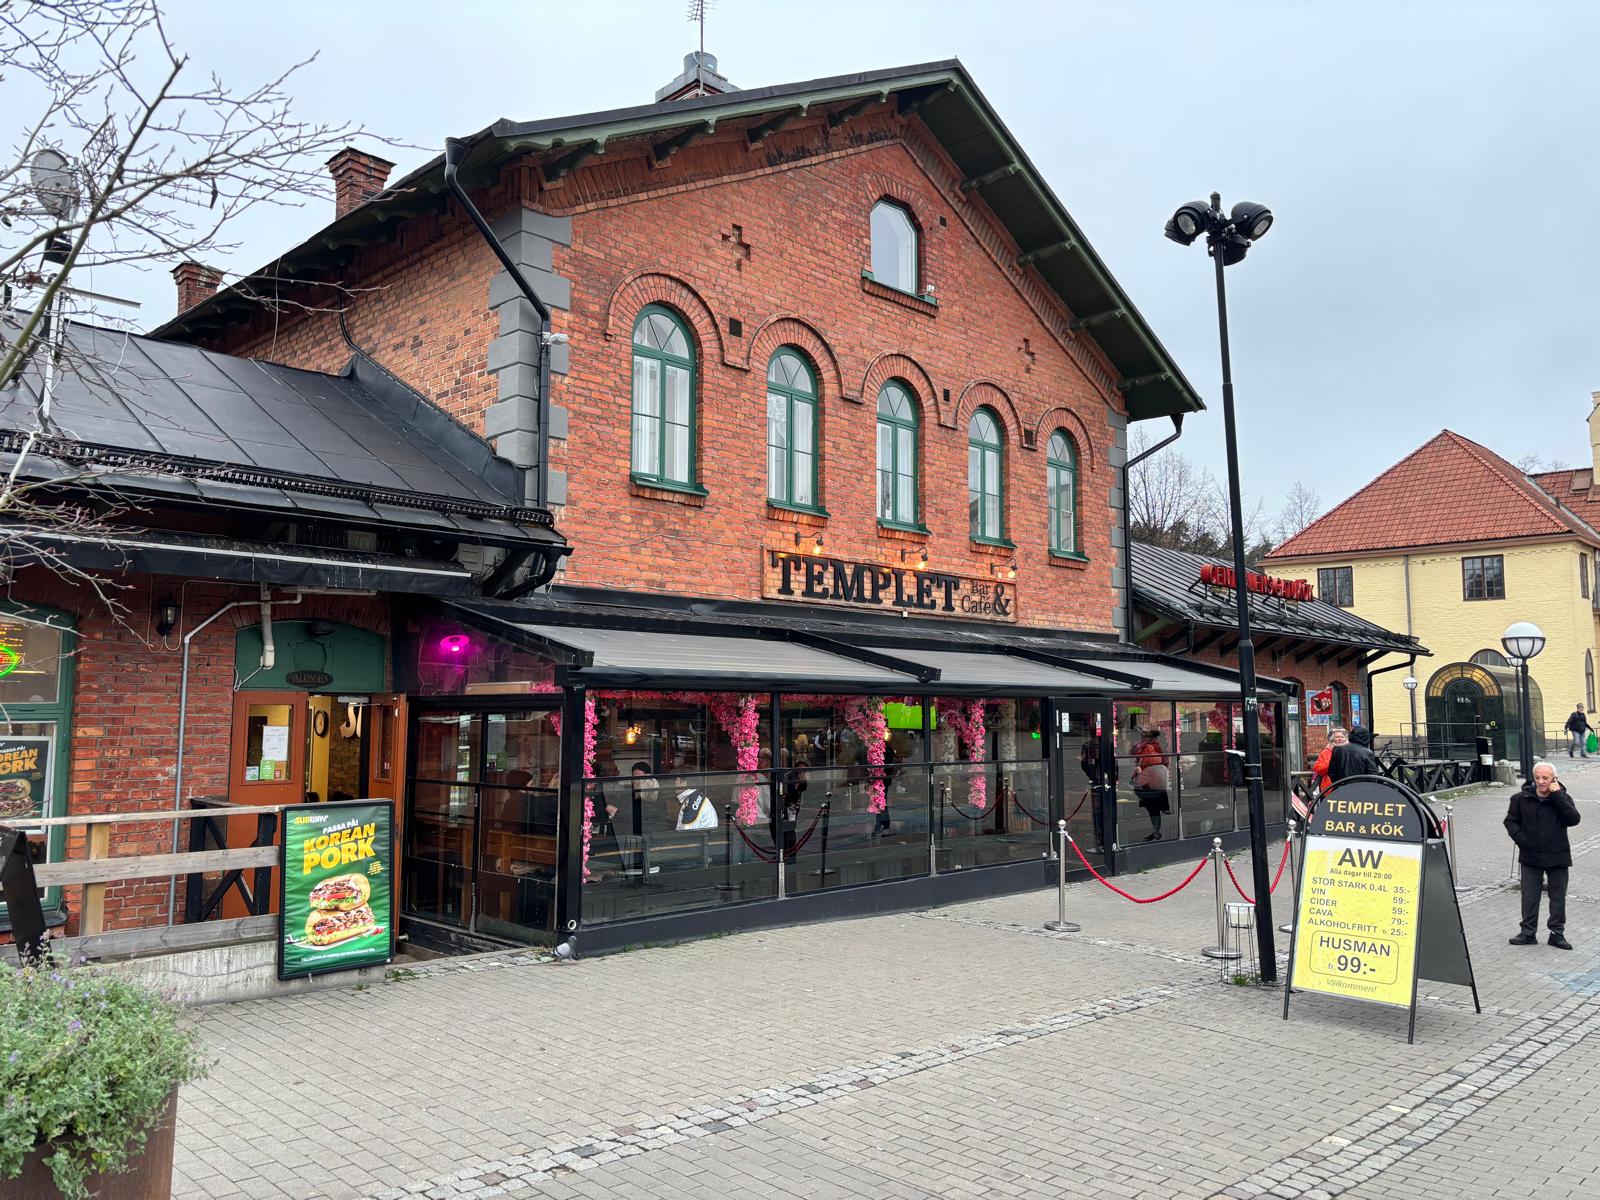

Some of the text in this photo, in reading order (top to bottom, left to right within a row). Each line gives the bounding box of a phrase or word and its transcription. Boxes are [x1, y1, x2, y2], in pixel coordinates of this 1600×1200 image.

[772, 551, 960, 612] TEMPLET
[970, 580, 991, 595] Bar
[961, 583, 1012, 616] Café &
[0, 756, 38, 774] ORK
[1327, 799, 1406, 817] TEMPLET
[294, 815, 329, 824] SUBWAY
[323, 824, 347, 834] PASSA
[1325, 820, 1404, 836] BAR & KÖK
[303, 823, 376, 854] KOREAN
[303, 836, 376, 876] PORK
[1337, 847, 1384, 870] AW
[1343, 869, 1362, 878] dagar
[1373, 872, 1392, 880] 20:00
[1311, 876, 1411, 895] STOR STARK 0.4L 35:-
[1311, 887, 1410, 905] VIN 59:-
[1309, 897, 1409, 916] CIDER 59:-
[1309, 907, 1409, 927] CAVA 79:-
[1307, 917, 1378, 934] ALKOHOLFRITT
[1390, 927, 1408, 937] 25:-
[1319, 935, 1391, 957] HUSMAN
[1328, 954, 1376, 975] fr. 99:-
